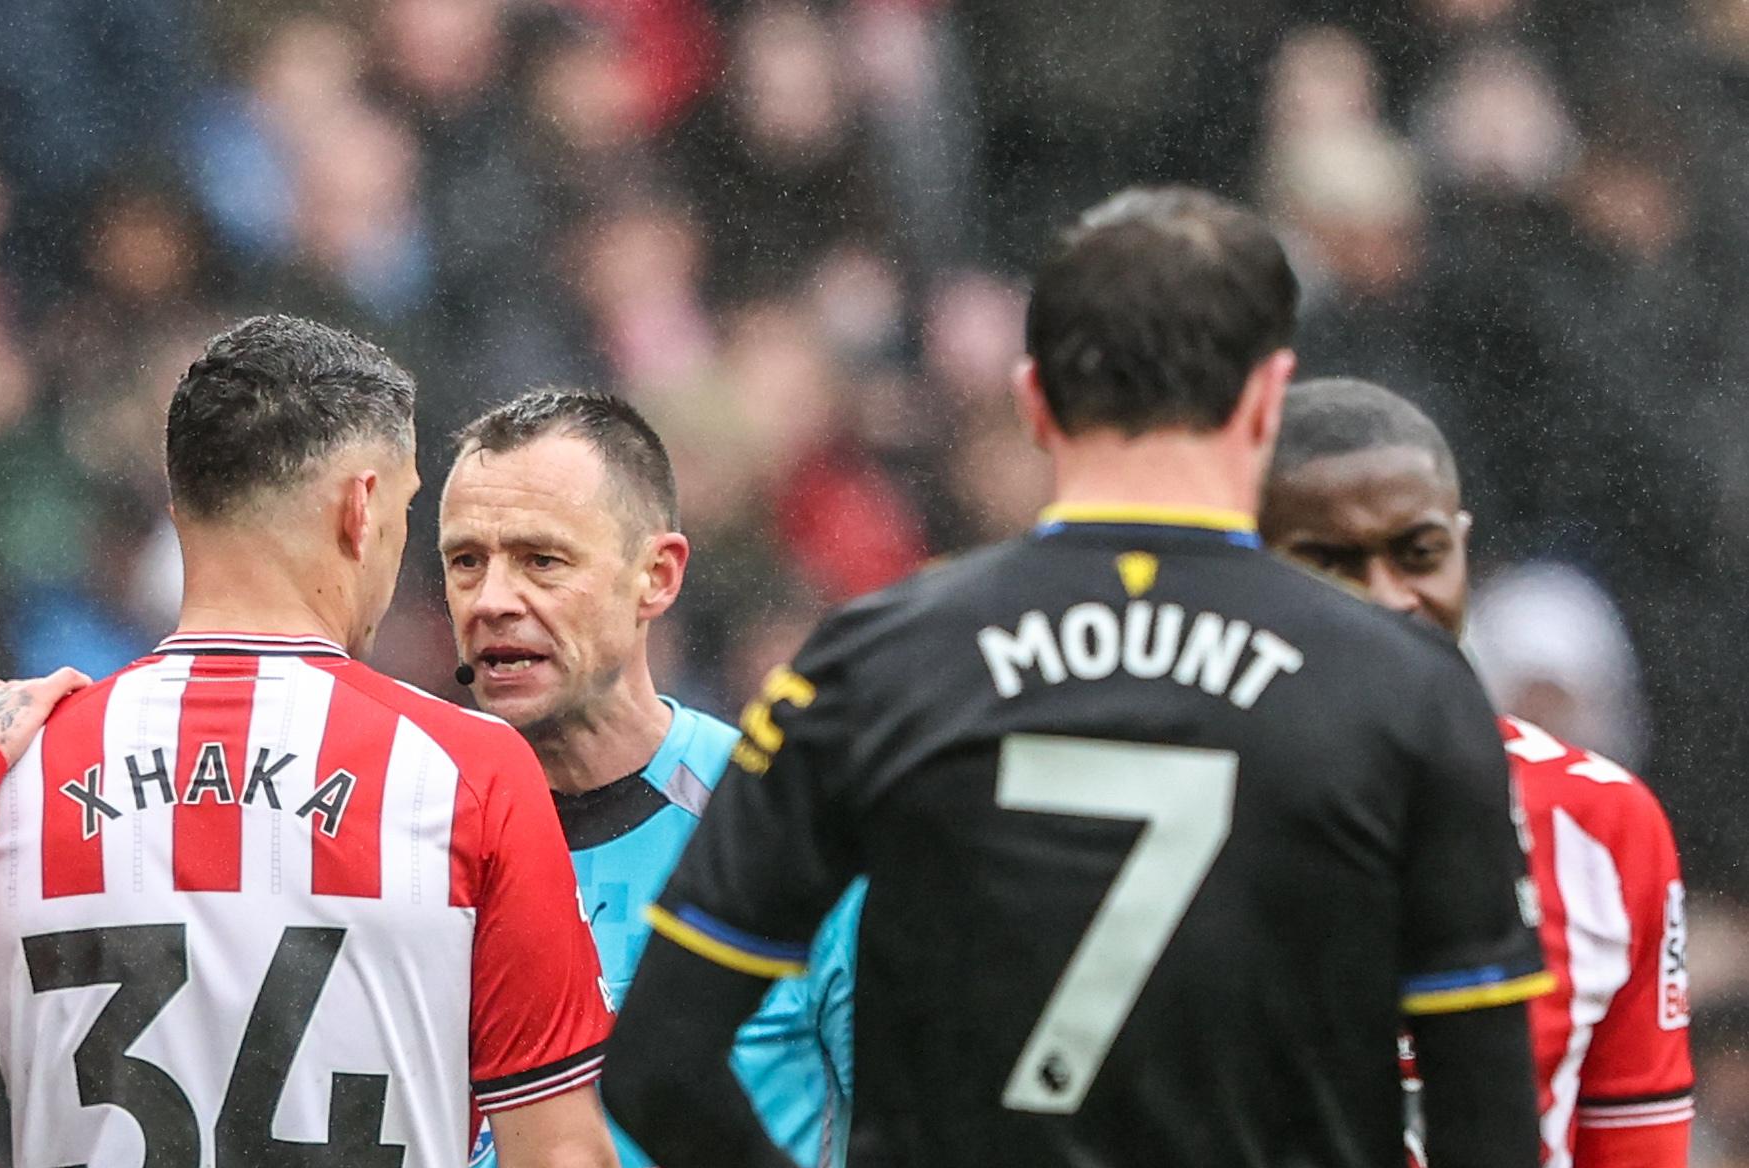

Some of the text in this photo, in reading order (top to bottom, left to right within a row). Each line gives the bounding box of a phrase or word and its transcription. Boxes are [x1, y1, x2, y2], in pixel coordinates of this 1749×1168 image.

[977, 600, 1304, 709] MOUNT
[59, 742, 357, 841] XHAKA
[996, 733, 1238, 1115] 7
